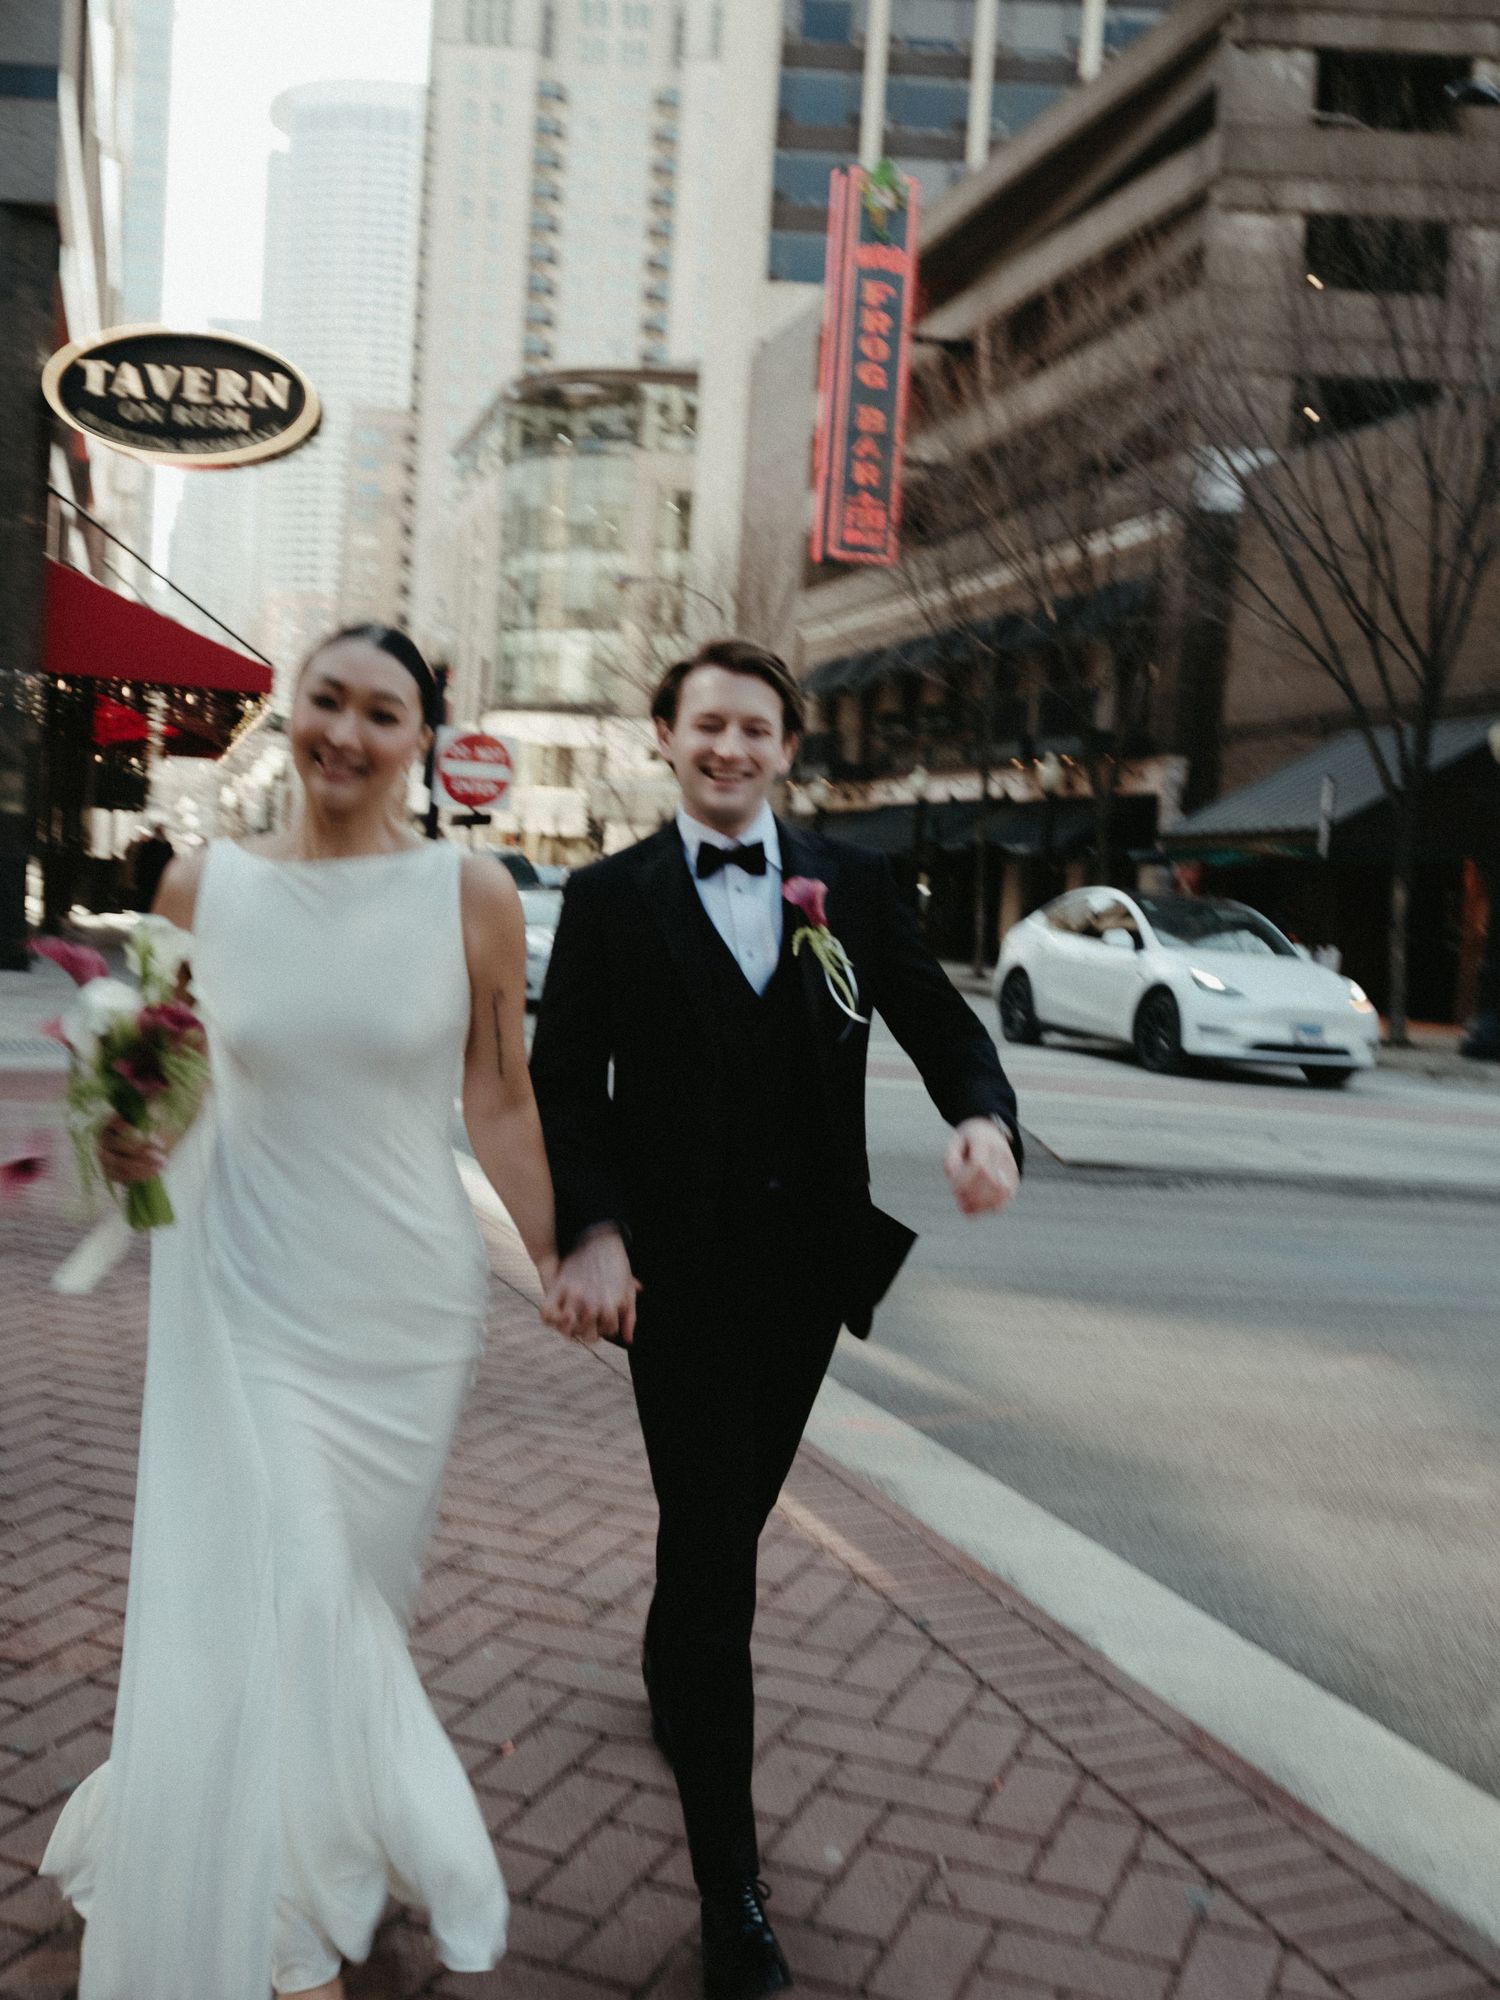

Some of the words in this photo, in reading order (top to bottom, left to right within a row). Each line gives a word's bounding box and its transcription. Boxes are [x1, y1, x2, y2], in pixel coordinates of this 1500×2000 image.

[856, 278, 897, 390] FROG
[76, 358, 292, 411] TAVERN
[116, 400, 167, 424] ON
[851, 403, 887, 488] BAR
[475, 745, 506, 763] NOT
